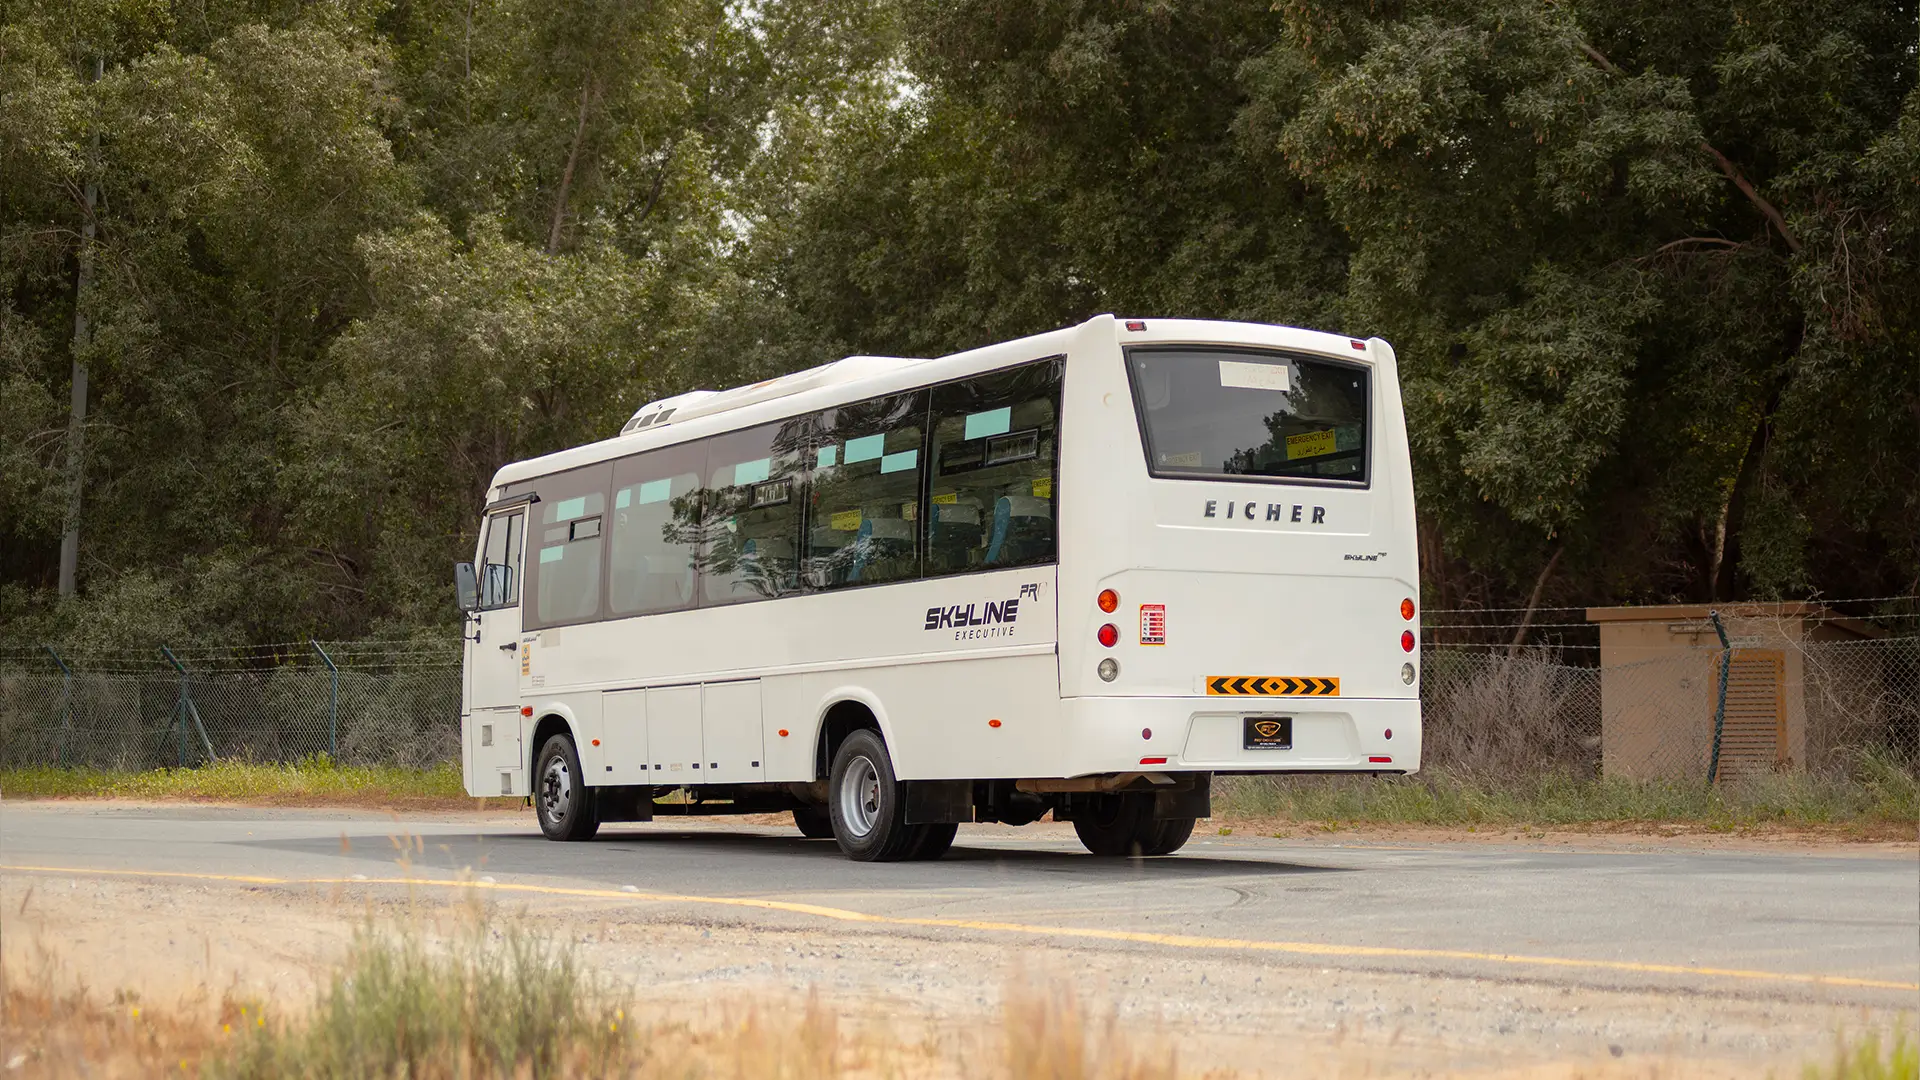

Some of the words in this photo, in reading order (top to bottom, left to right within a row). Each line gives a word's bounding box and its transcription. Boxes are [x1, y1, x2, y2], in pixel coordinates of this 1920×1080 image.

[1286, 433, 1320, 445] EMERGENCY
[1321, 430, 1334, 440] EXIT
[1204, 500, 1326, 525] EICHER
[1343, 554, 1378, 562] SKYLINE
[924, 599, 1019, 631] SKYLINE
[955, 626, 1014, 641] EXECUTIVE
